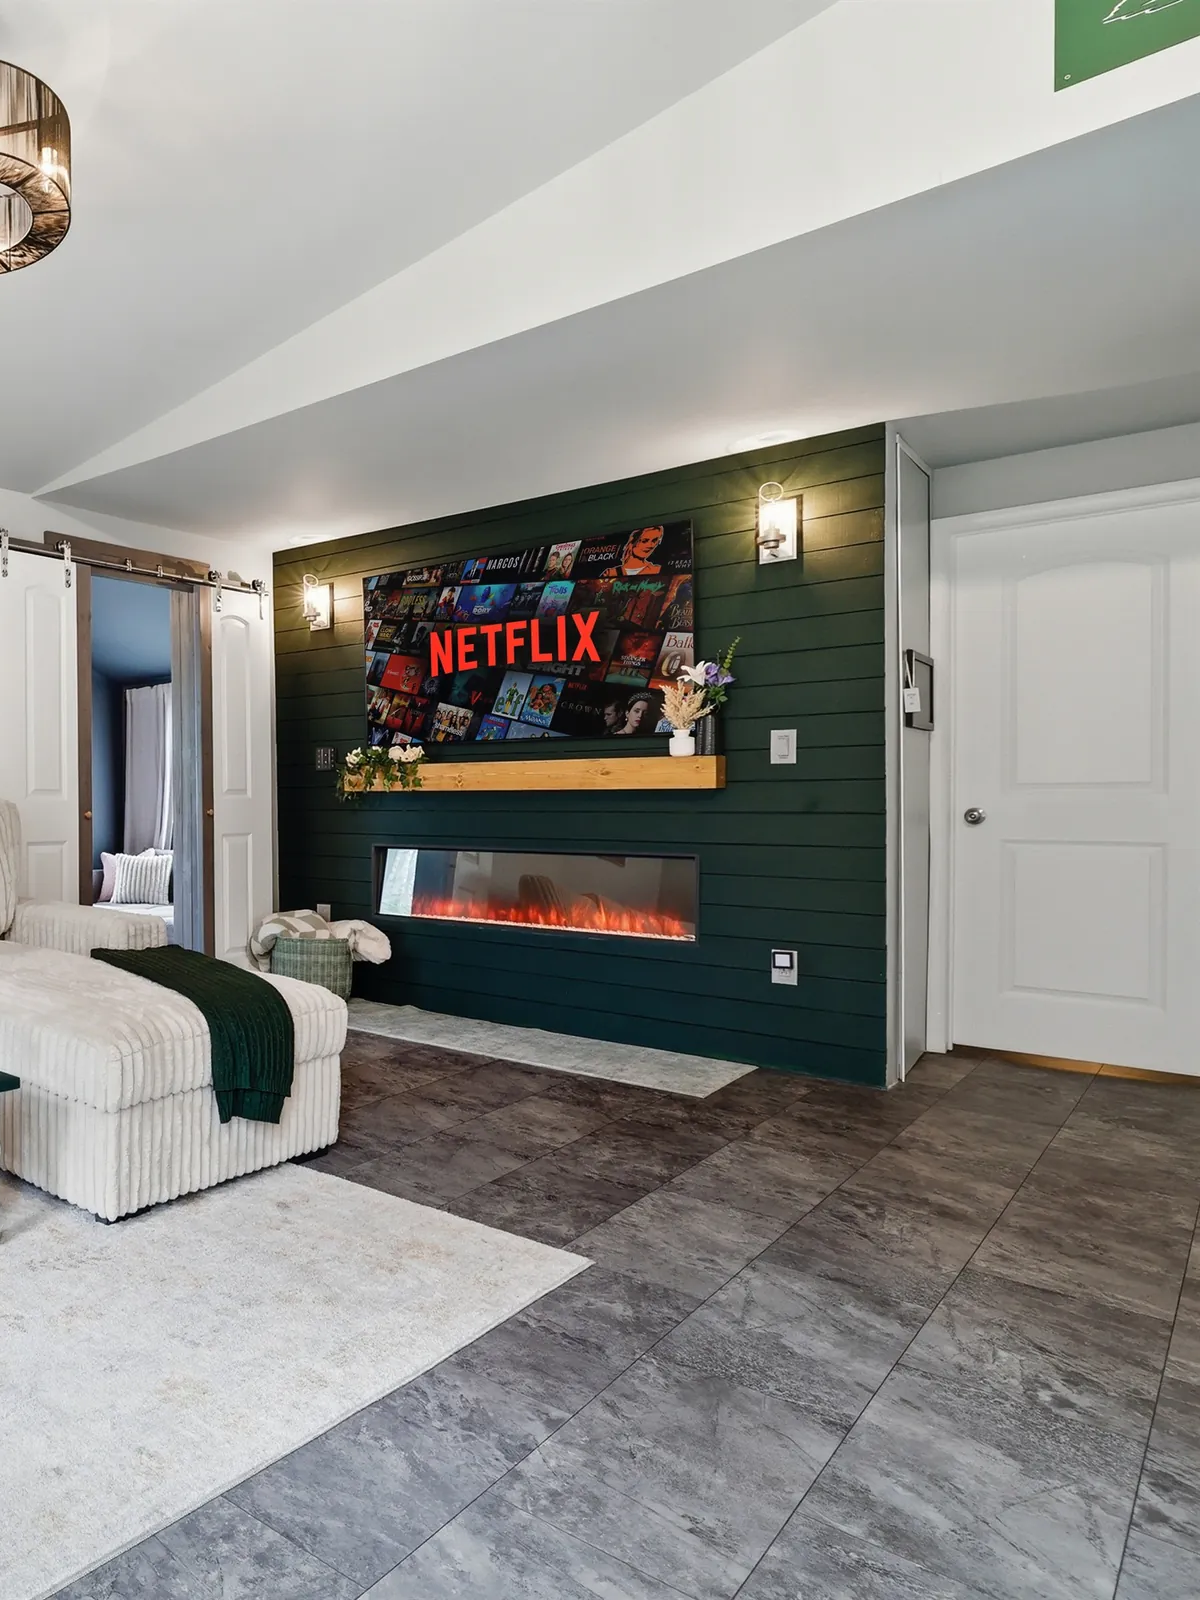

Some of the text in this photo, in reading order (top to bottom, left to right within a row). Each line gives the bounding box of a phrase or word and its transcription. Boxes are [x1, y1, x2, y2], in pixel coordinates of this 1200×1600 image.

[584, 545, 617, 554] ORANGE
[486, 556, 520, 570] NARCOS
[588, 552, 616, 562] BLACK
[429, 611, 601, 678] NETFLIX
[560, 701, 603, 715] CROWN
